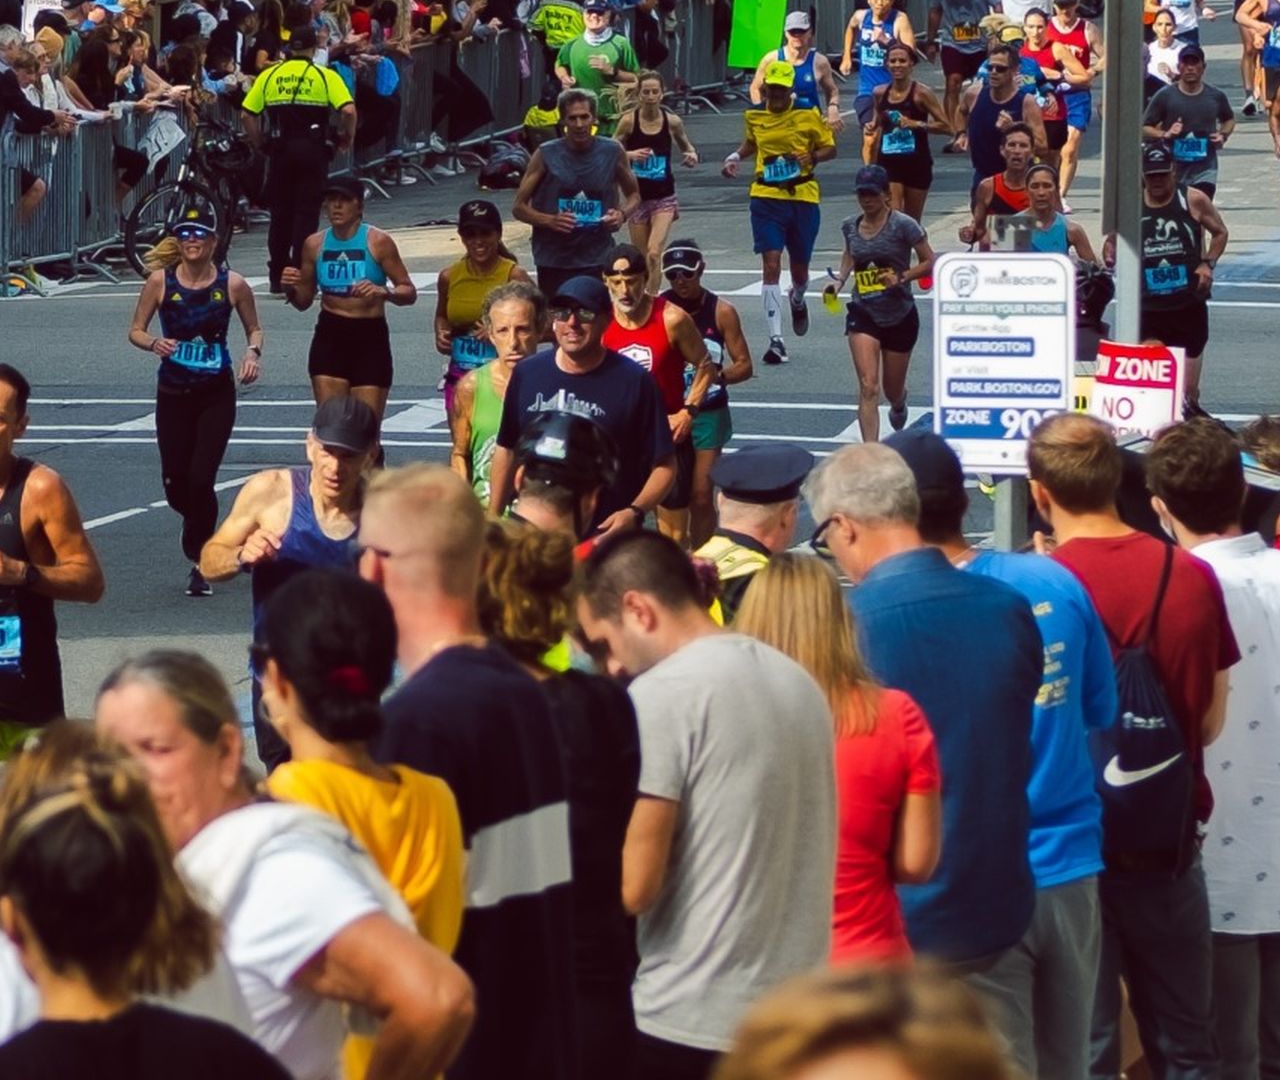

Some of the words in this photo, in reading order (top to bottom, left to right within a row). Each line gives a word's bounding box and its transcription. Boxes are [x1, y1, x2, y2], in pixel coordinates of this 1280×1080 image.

[942, 303, 963, 313] PAY
[965, 303, 993, 313] WITH
[994, 303, 1025, 313] YOUR
[1026, 303, 1064, 313] PHONE
[950, 341, 1031, 353] PARKBOSTON
[1115, 357, 1171, 382] ZONE
[950, 382, 1060, 395] PARK.BOSTON.GOV
[1102, 397, 1134, 420] NO
[945, 409, 991, 425] ZONE
[1000, 408, 1060, 439] 90
